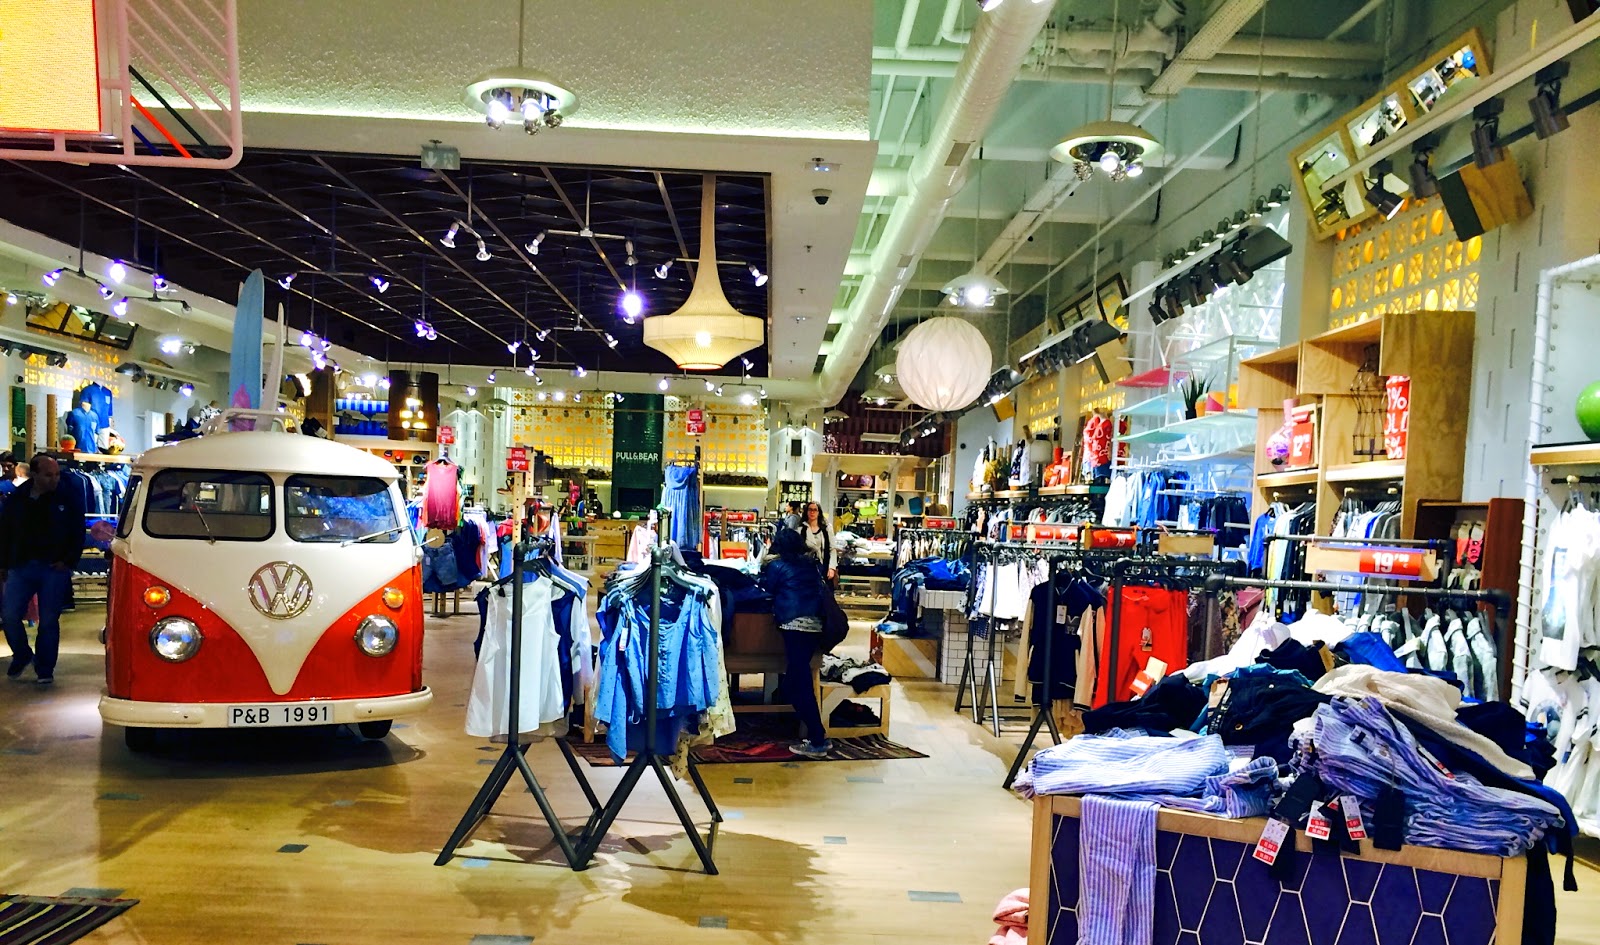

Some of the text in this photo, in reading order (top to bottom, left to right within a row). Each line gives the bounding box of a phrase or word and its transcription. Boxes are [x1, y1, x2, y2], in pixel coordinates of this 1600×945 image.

[615, 451, 659, 461] PULL&BEAR
[248, 561, 313, 620] VW
[233, 706, 328, 724] P&B 1991
